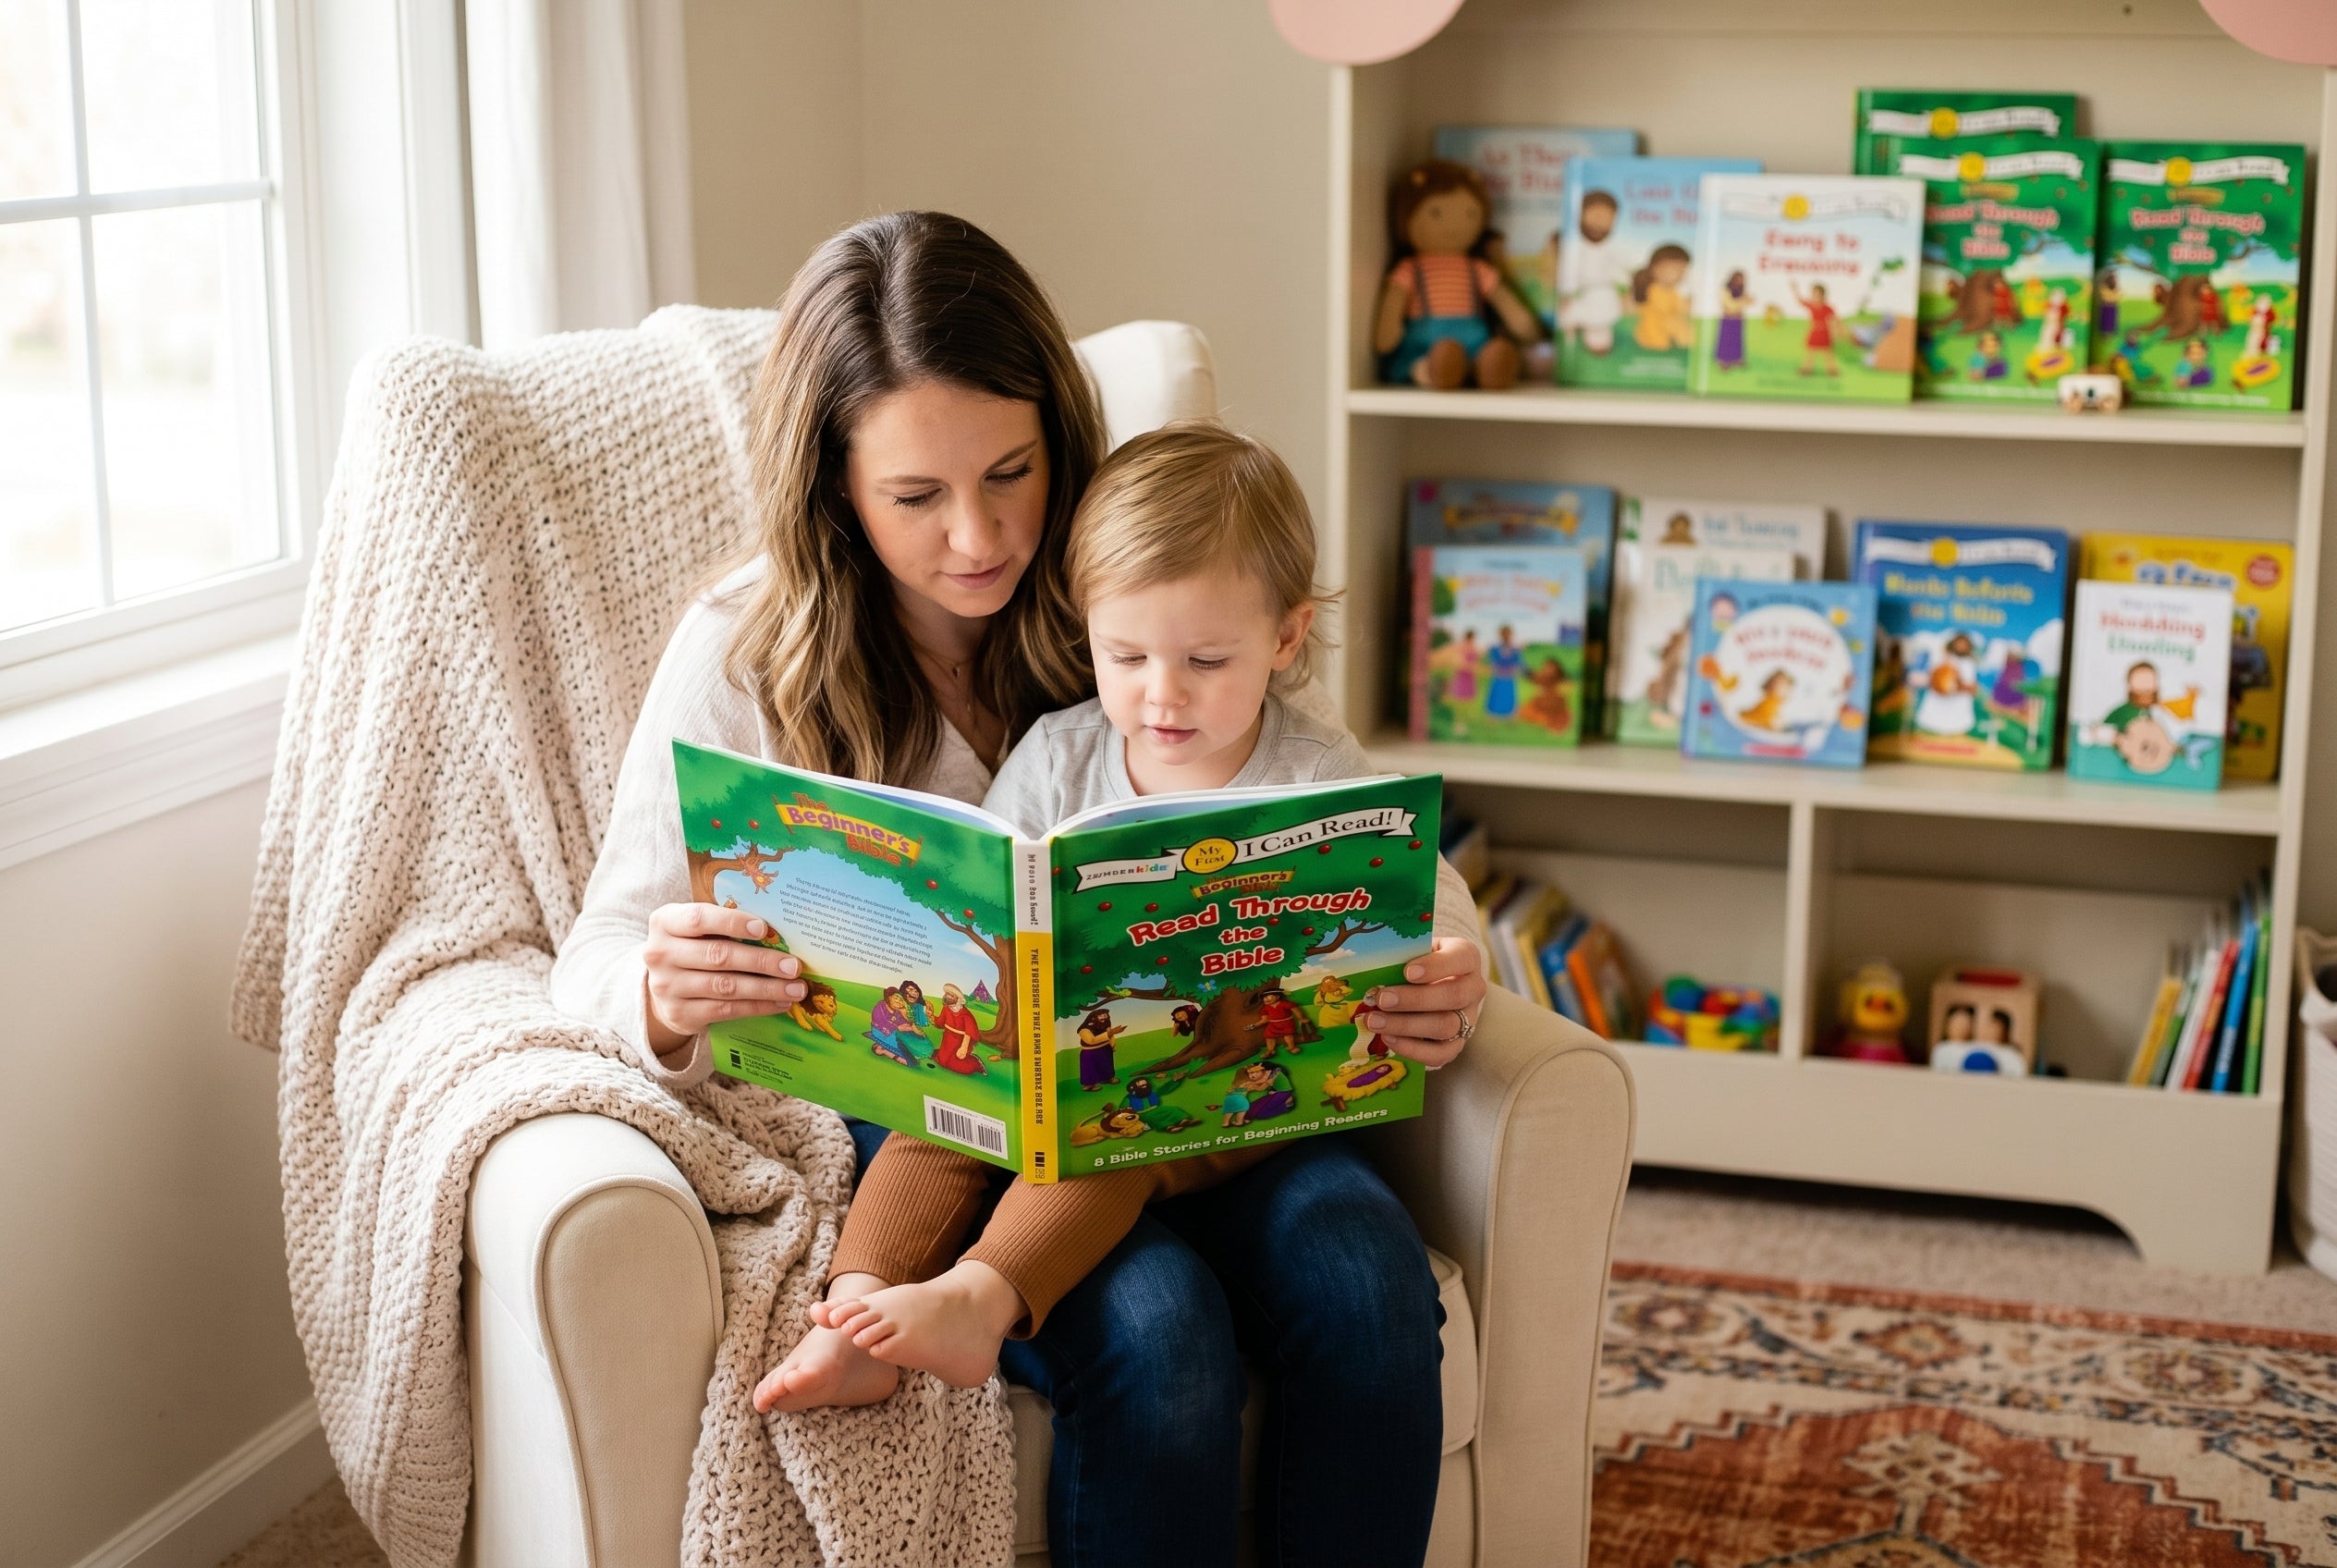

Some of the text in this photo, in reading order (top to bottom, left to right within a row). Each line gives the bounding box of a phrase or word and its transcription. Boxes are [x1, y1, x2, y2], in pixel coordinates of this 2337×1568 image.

[786, 806, 911, 854] Beginner's
[1199, 846, 1221, 857] My
[1244, 811, 1393, 857] I Can Read!
[1127, 888, 1372, 947] Read Through
[1219, 925, 1268, 945] the
[1201, 946, 1284, 975] Bible
[1095, 1109, 1388, 1167] 8 Bible Stories for Beginning Readers
